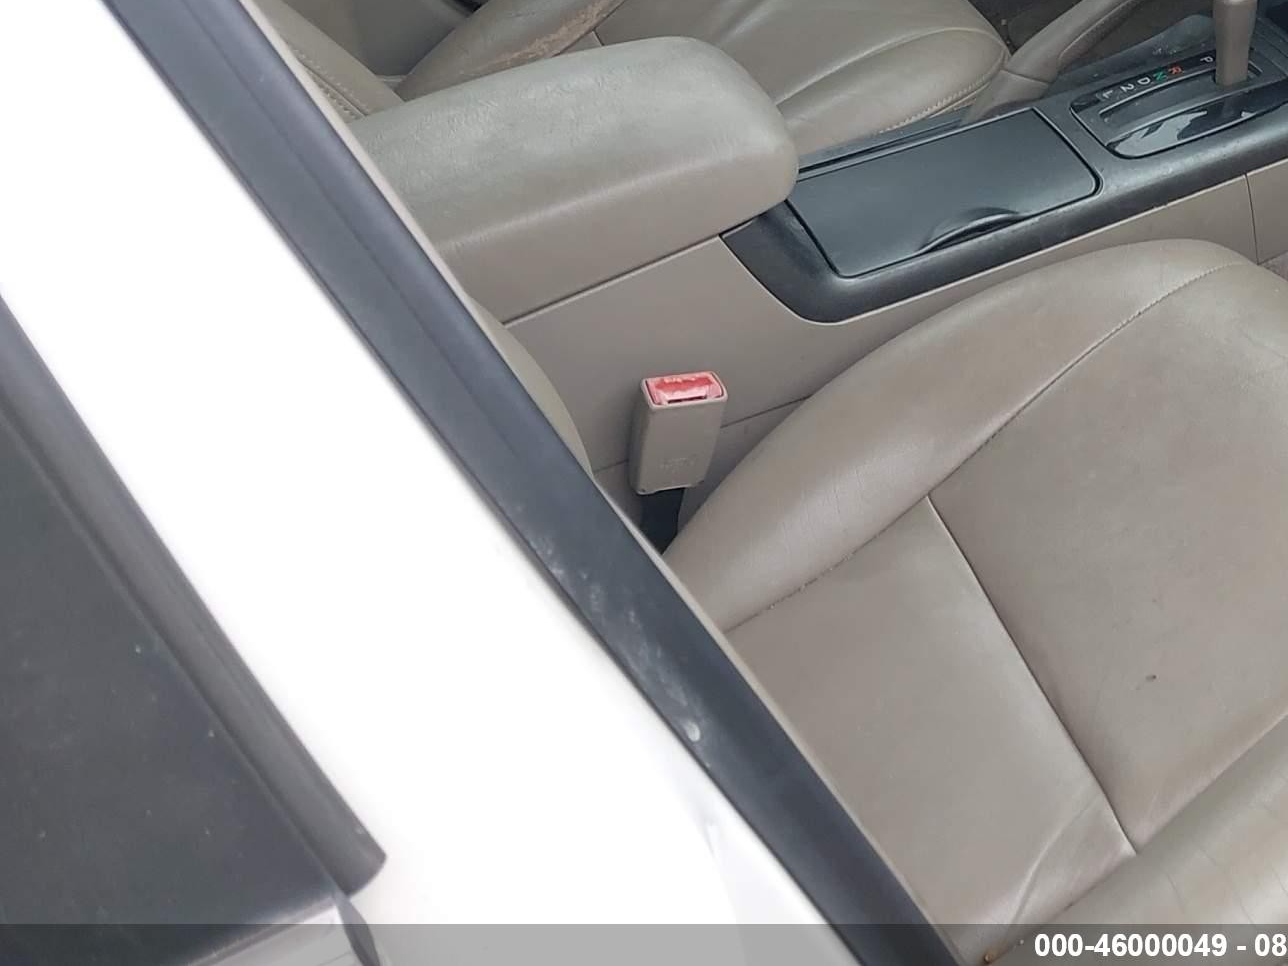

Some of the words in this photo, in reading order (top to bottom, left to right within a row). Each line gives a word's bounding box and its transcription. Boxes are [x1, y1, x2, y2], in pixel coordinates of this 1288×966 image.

[1199, 55, 1214, 64] P
[1167, 65, 1184, 76] R
[1136, 76, 1151, 86] D
[1152, 70, 1169, 83] N
[1119, 83, 1135, 94] 2
[1101, 89, 1115, 100] L
